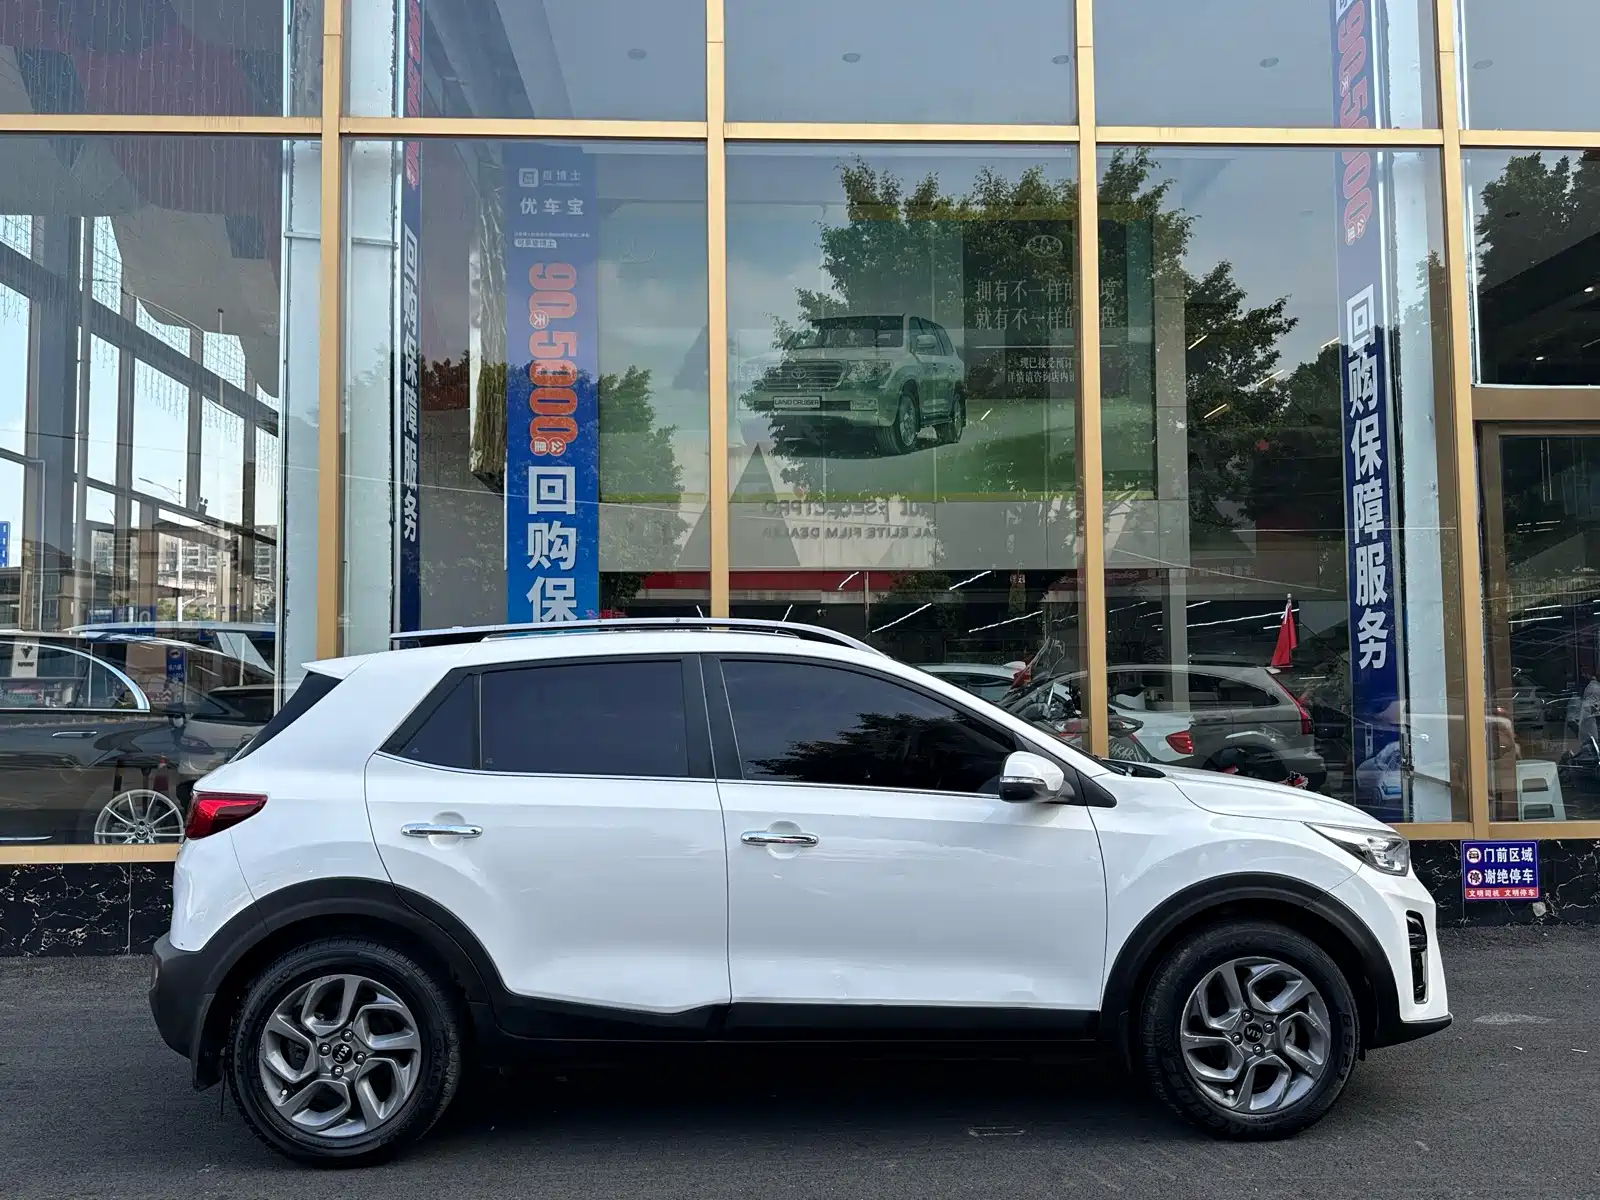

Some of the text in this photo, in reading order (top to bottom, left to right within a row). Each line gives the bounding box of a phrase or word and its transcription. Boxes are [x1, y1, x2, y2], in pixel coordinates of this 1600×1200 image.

[520, 197, 584, 215] 优车宝
[403, 223, 418, 543] 回购保障服务
[1345, 283, 1389, 670] 回购保障服务
[526, 466, 579, 623] 回购保
[1484, 847, 1533, 863] 门前区域
[1484, 868, 1534, 885] 谢绝停车
[1468, 888, 1535, 898] 文明司机 文明停车
